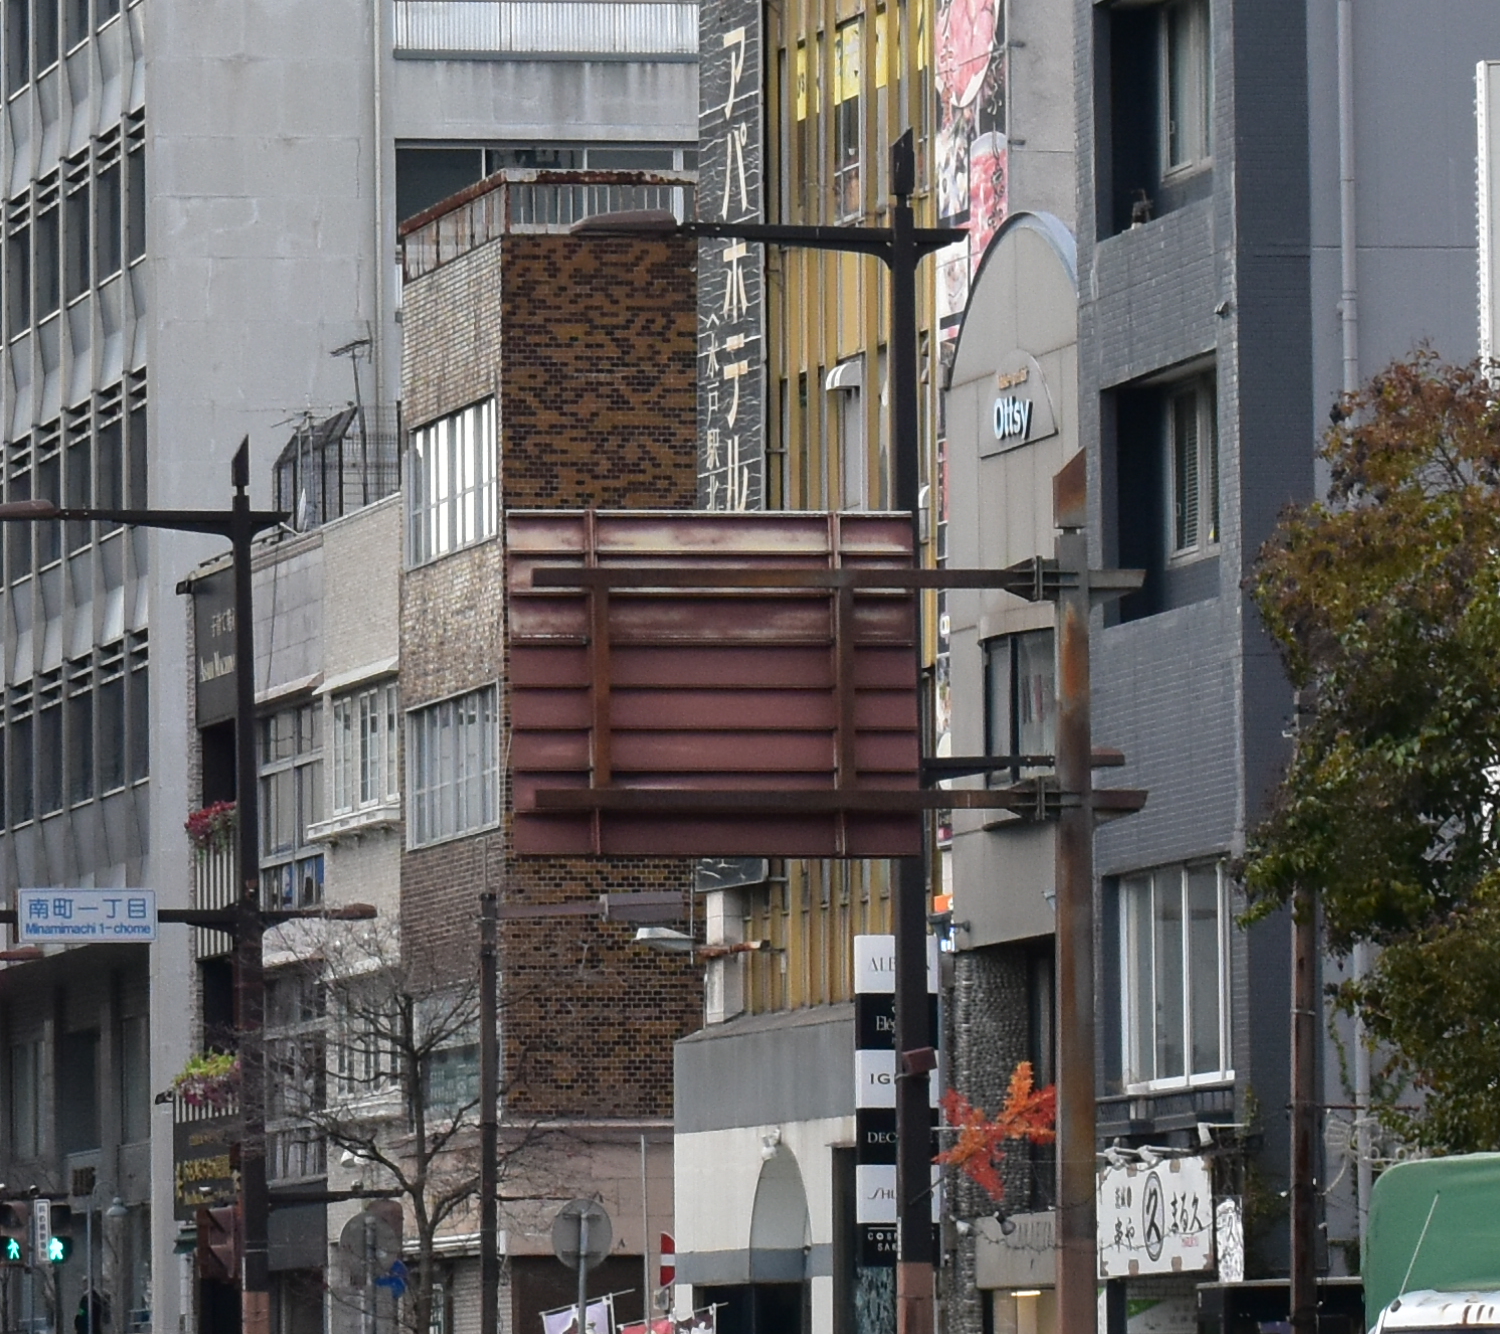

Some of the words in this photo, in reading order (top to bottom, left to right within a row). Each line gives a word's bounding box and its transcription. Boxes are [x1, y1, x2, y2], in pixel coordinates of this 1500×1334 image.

[28, 897, 148, 919] 南町一丁目
[25, 922, 97, 934] Minamimachi
[100, 922, 152, 934] 1-chome
